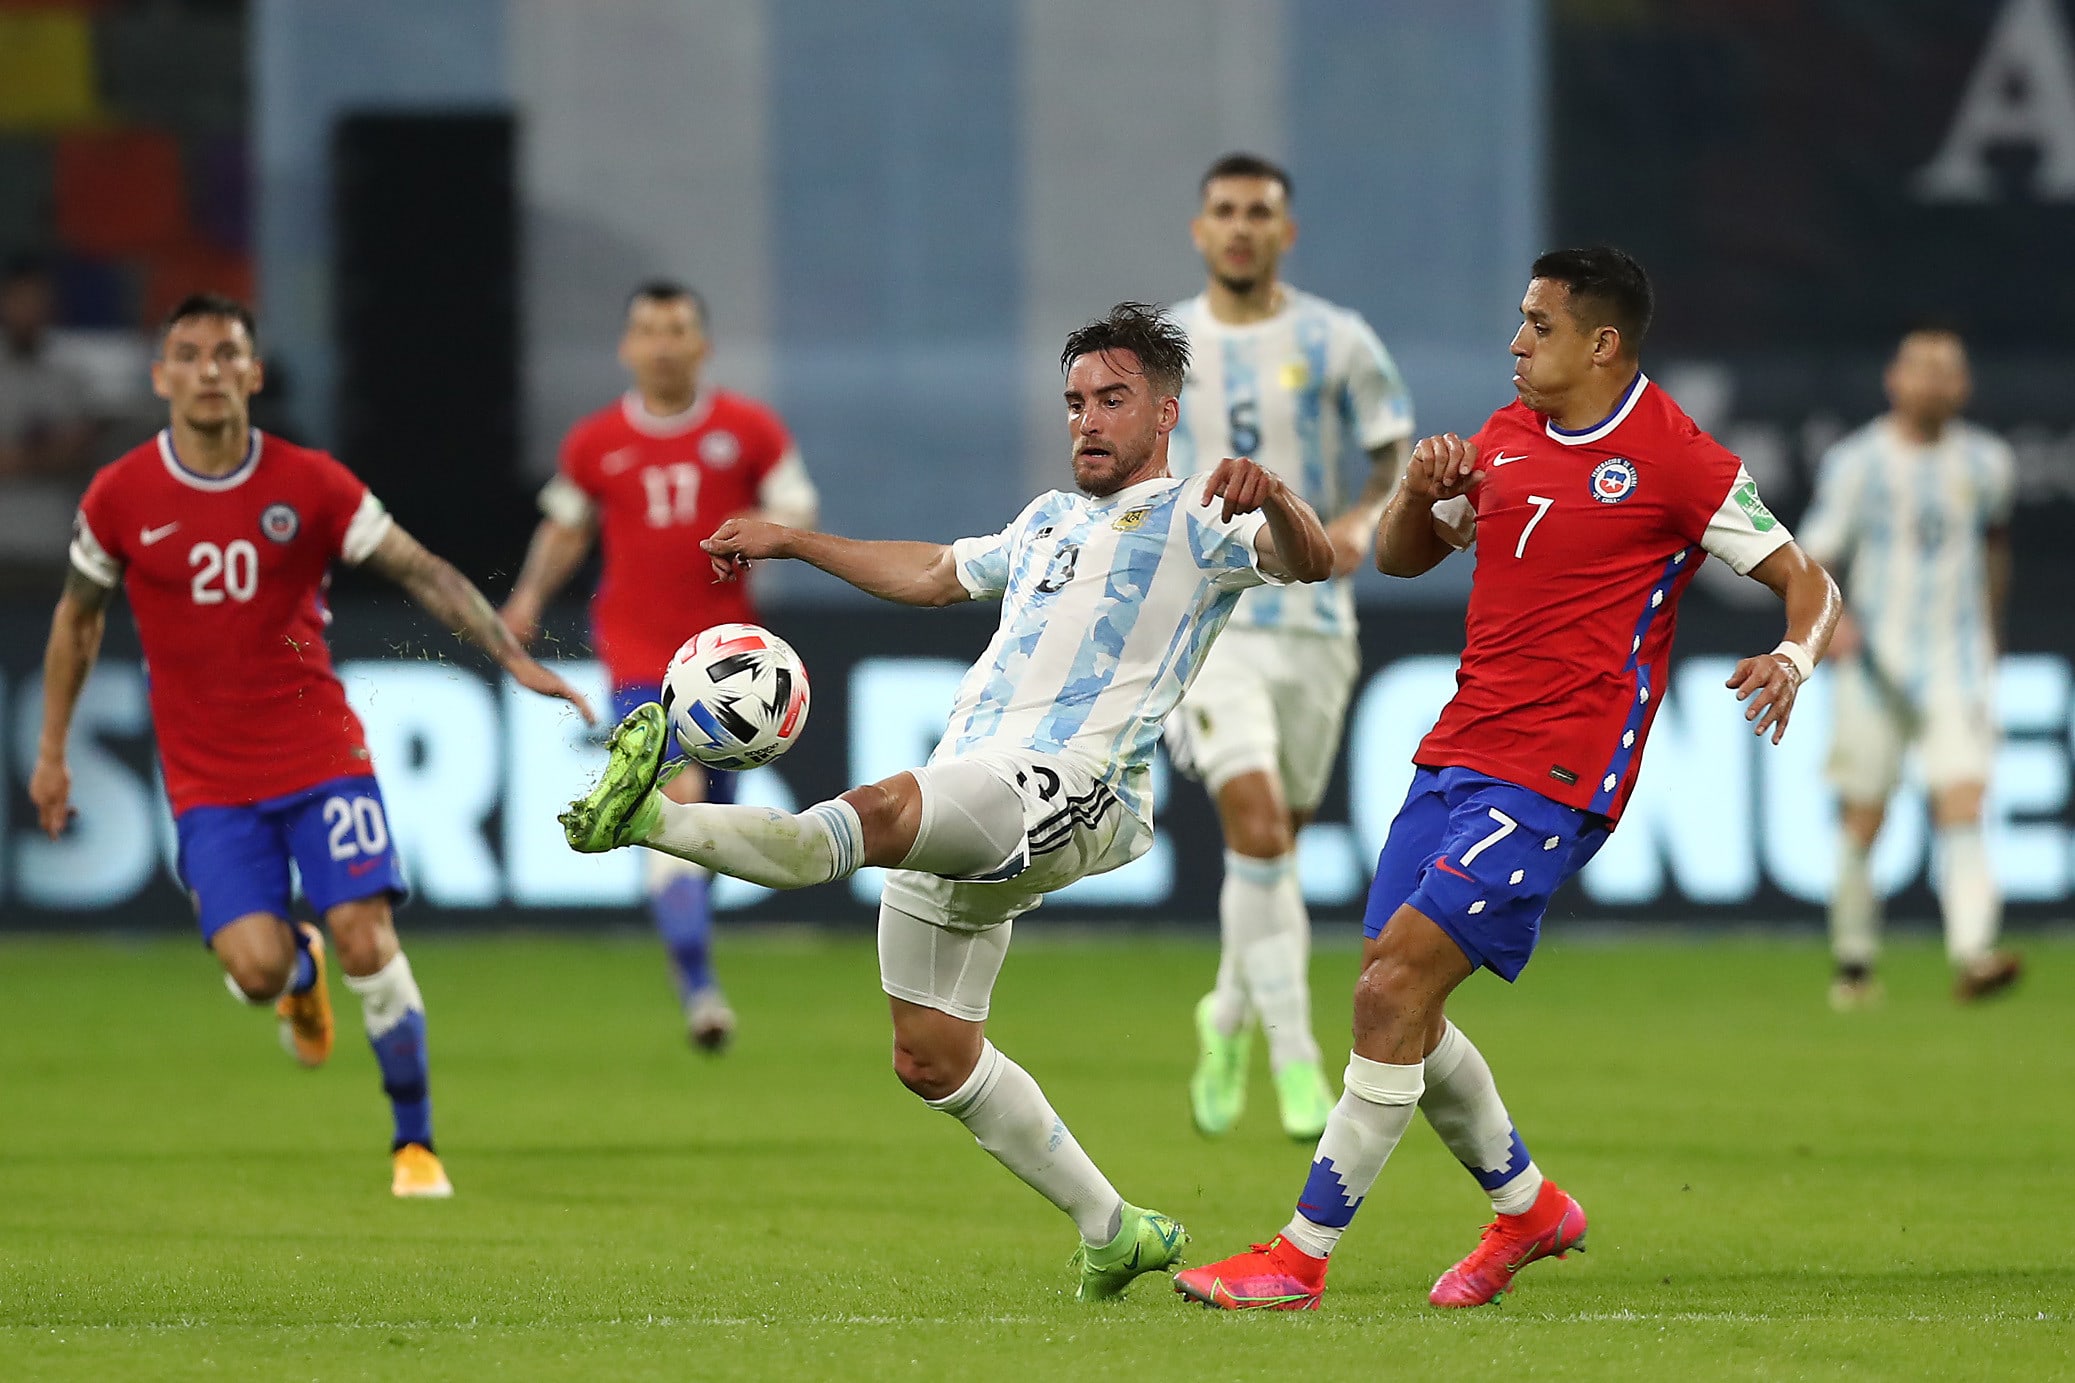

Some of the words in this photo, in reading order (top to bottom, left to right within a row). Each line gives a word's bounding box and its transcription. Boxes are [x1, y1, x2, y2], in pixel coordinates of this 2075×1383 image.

[1230, 401, 1260, 456] 5
[643, 463, 699, 527] 17
[1514, 495, 1555, 558] 7
[188, 539, 259, 604] 20
[1034, 543, 1080, 593] 3
[323, 796, 389, 861] 20
[1460, 807, 1518, 867] 7
